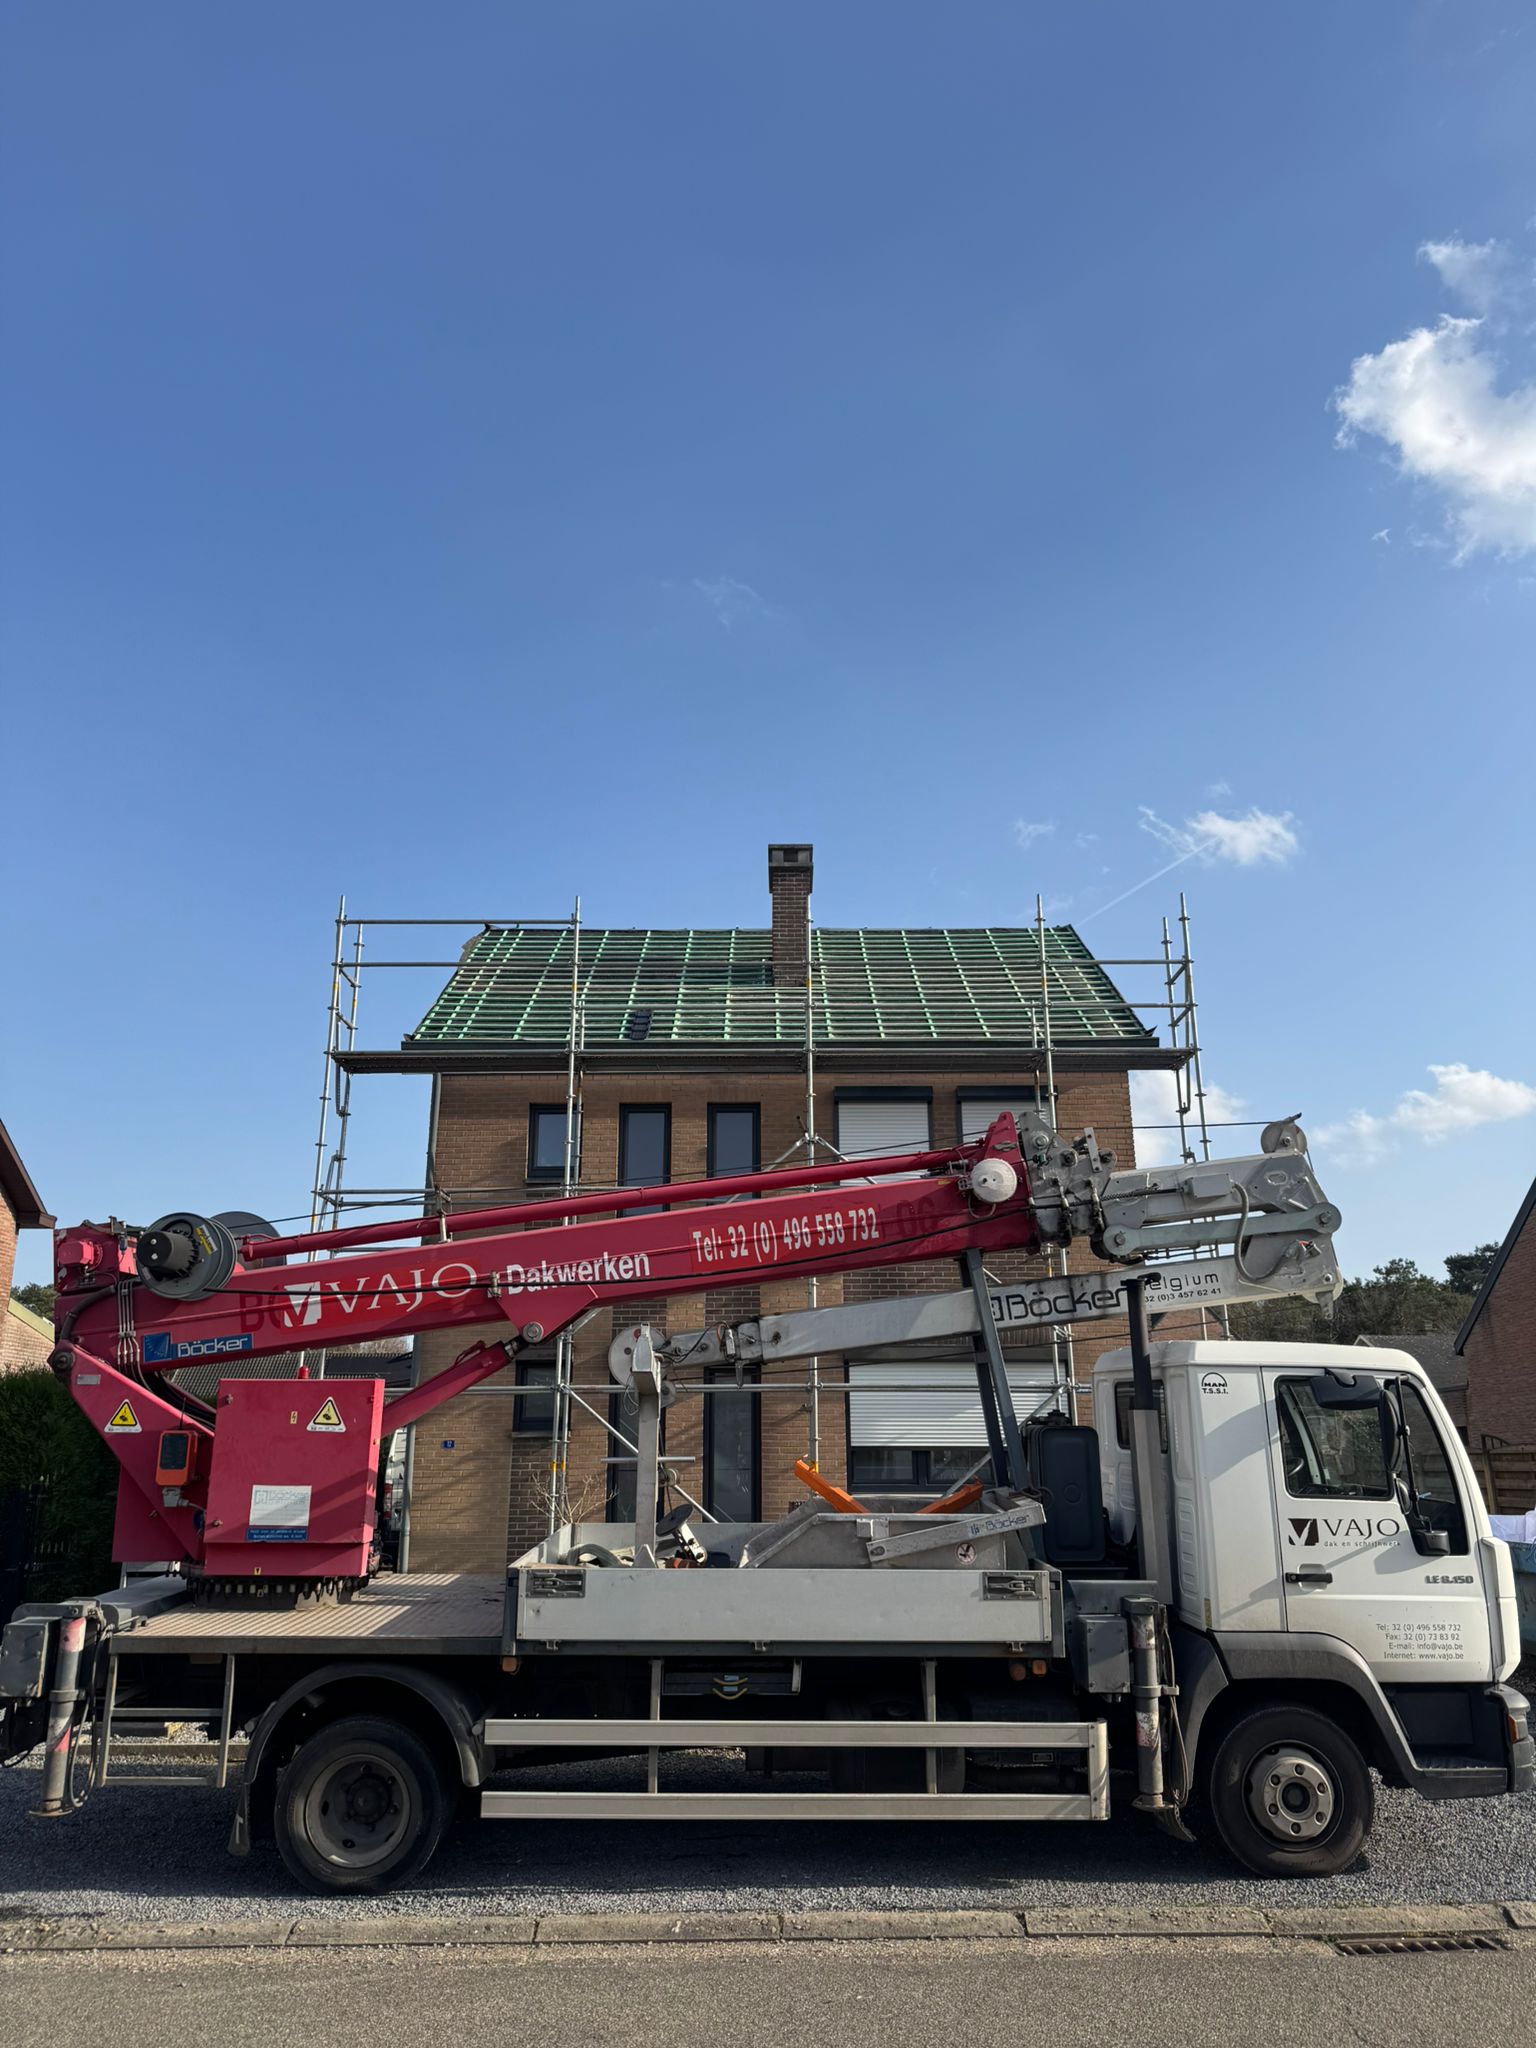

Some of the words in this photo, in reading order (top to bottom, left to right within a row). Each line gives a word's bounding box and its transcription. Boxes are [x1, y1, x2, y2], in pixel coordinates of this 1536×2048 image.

[693, 1228, 724, 1263] Tel:
[727, 1224, 749, 1259] 32
[753, 1220, 777, 1263] (0)
[783, 1215, 812, 1251] 496
[815, 1211, 846, 1247] 558
[849, 1207, 880, 1242] 732
[506, 1251, 650, 1295] Dakwerken
[1143, 1272, 1219, 1292] elgium
[326, 1262, 477, 1314] VAJO
[1177, 1291, 1194, 1299] 457
[1008, 1286, 1128, 1321] Böcker
[178, 1338, 248, 1358] Böcker
[1322, 1518, 1400, 1540] VAJO
[1376, 1623, 1389, 1631] Tel:
[1392, 1623, 1401, 1631] 32
[1403, 1623, 1414, 1632] (0)
[1416, 1623, 1431, 1631] 496
[1432, 1623, 1446, 1631] 558
[1448, 1623, 1461, 1631] 732
[1415, 1633, 1426, 1641] (0)
[1384, 1651, 1416, 1659] Internet:
[1418, 1651, 1464, 1660] www.vajo.be
[1389, 1642, 1415, 1650] E-mail:
[1417, 1642, 1463, 1651] info@vajo.be
